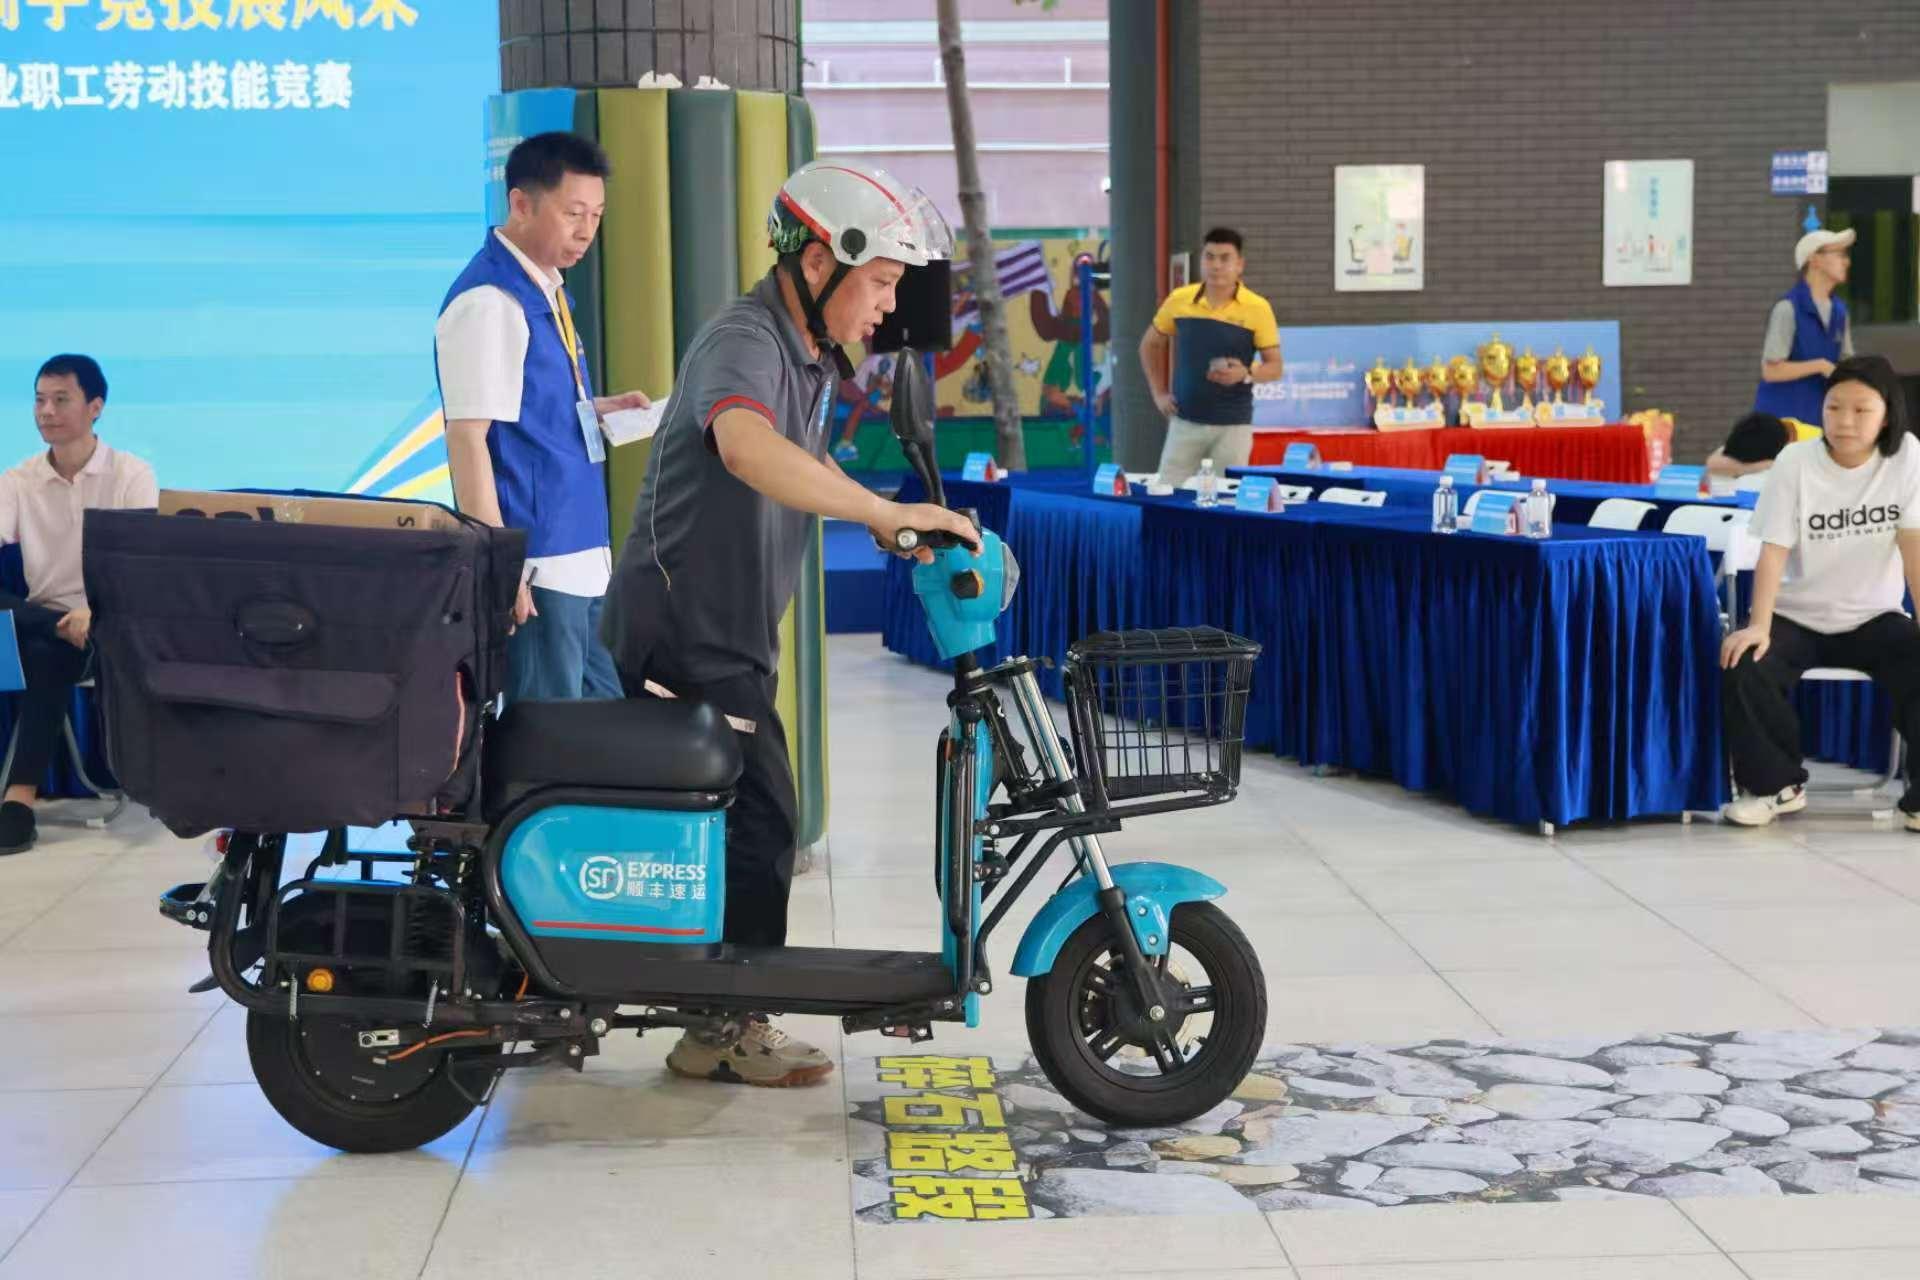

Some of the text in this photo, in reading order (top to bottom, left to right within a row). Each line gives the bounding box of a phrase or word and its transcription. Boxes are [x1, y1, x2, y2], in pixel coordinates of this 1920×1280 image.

[1808, 504, 1900, 530] adidas
[627, 861, 707, 881] EXPRESS
[626, 880, 707, 900] 顺丰速运
[876, 1055, 1032, 1220] 碎石路段
